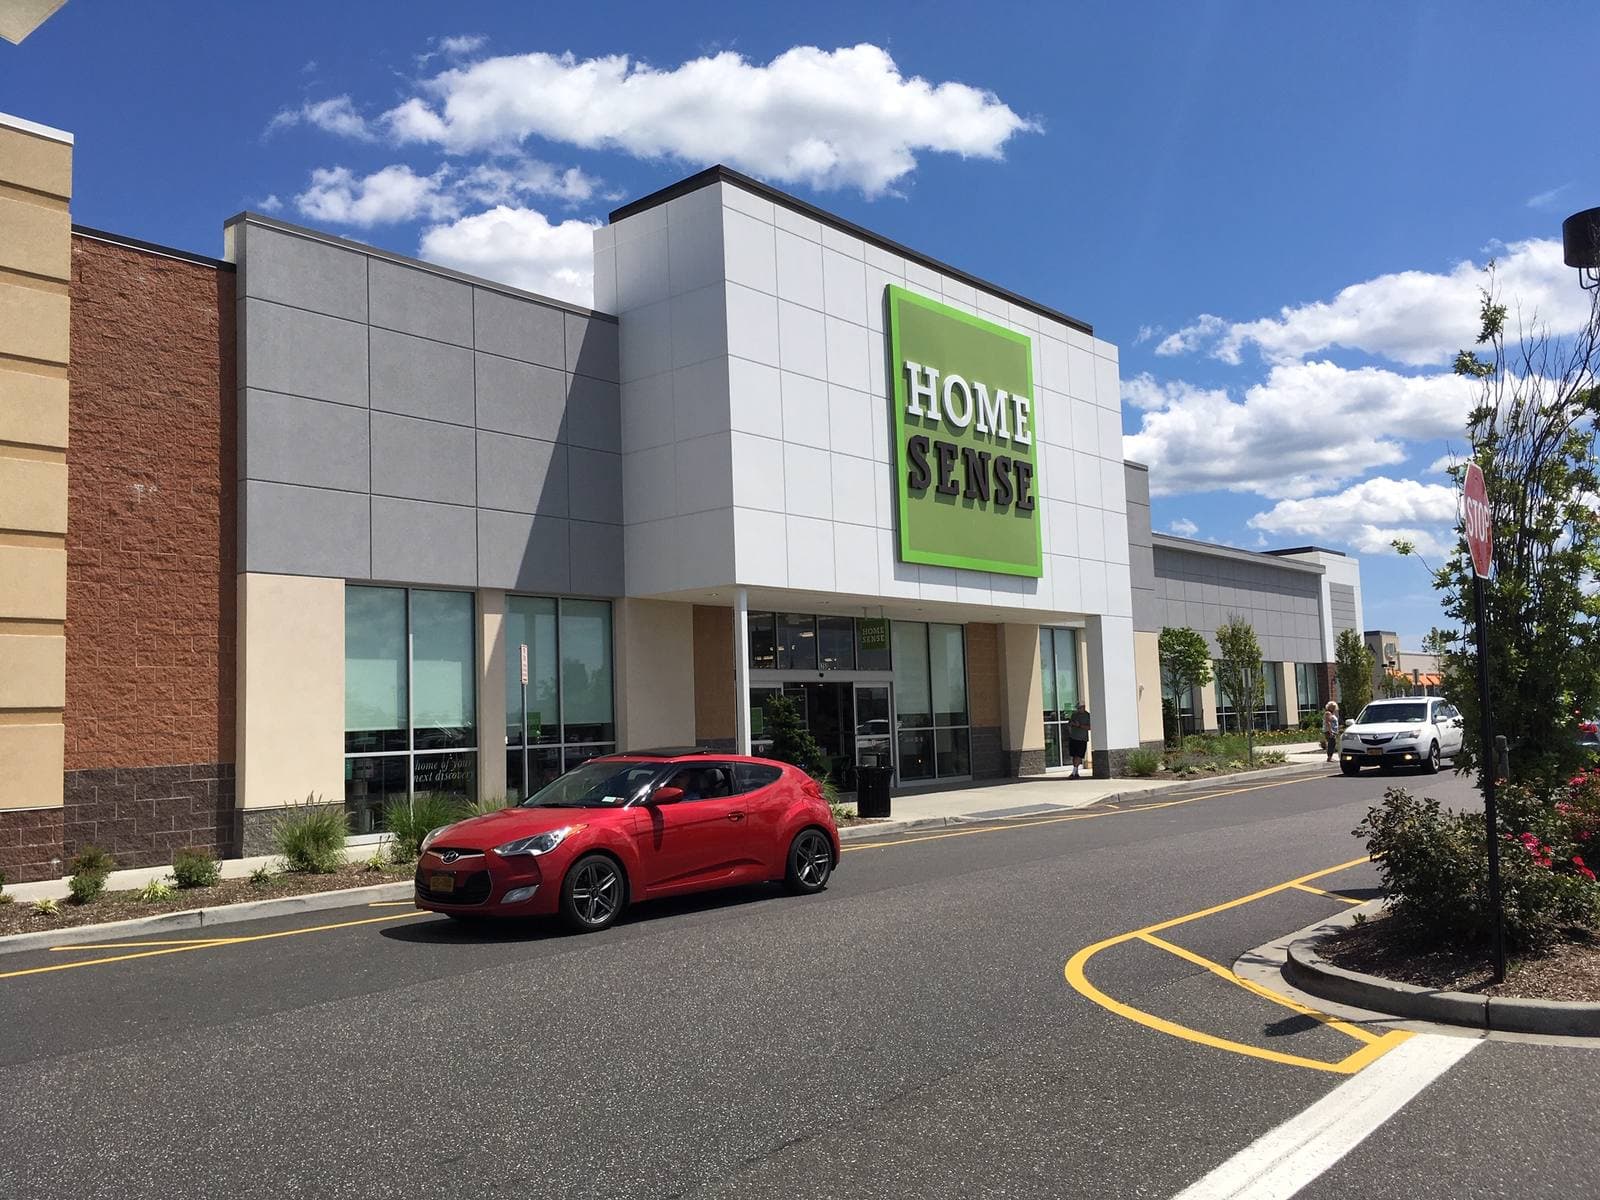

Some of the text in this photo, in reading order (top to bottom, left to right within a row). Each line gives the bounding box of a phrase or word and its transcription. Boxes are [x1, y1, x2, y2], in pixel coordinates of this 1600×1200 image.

[906, 360, 1032, 445] HOME
[907, 435, 1035, 511] SENSE
[1466, 496, 1490, 543] STOP
[862, 626, 885, 635] HOME
[862, 634, 885, 642] SENSE
[414, 760, 438, 770] home
[440, 758, 450, 772] of
[414, 771, 433, 782] next
